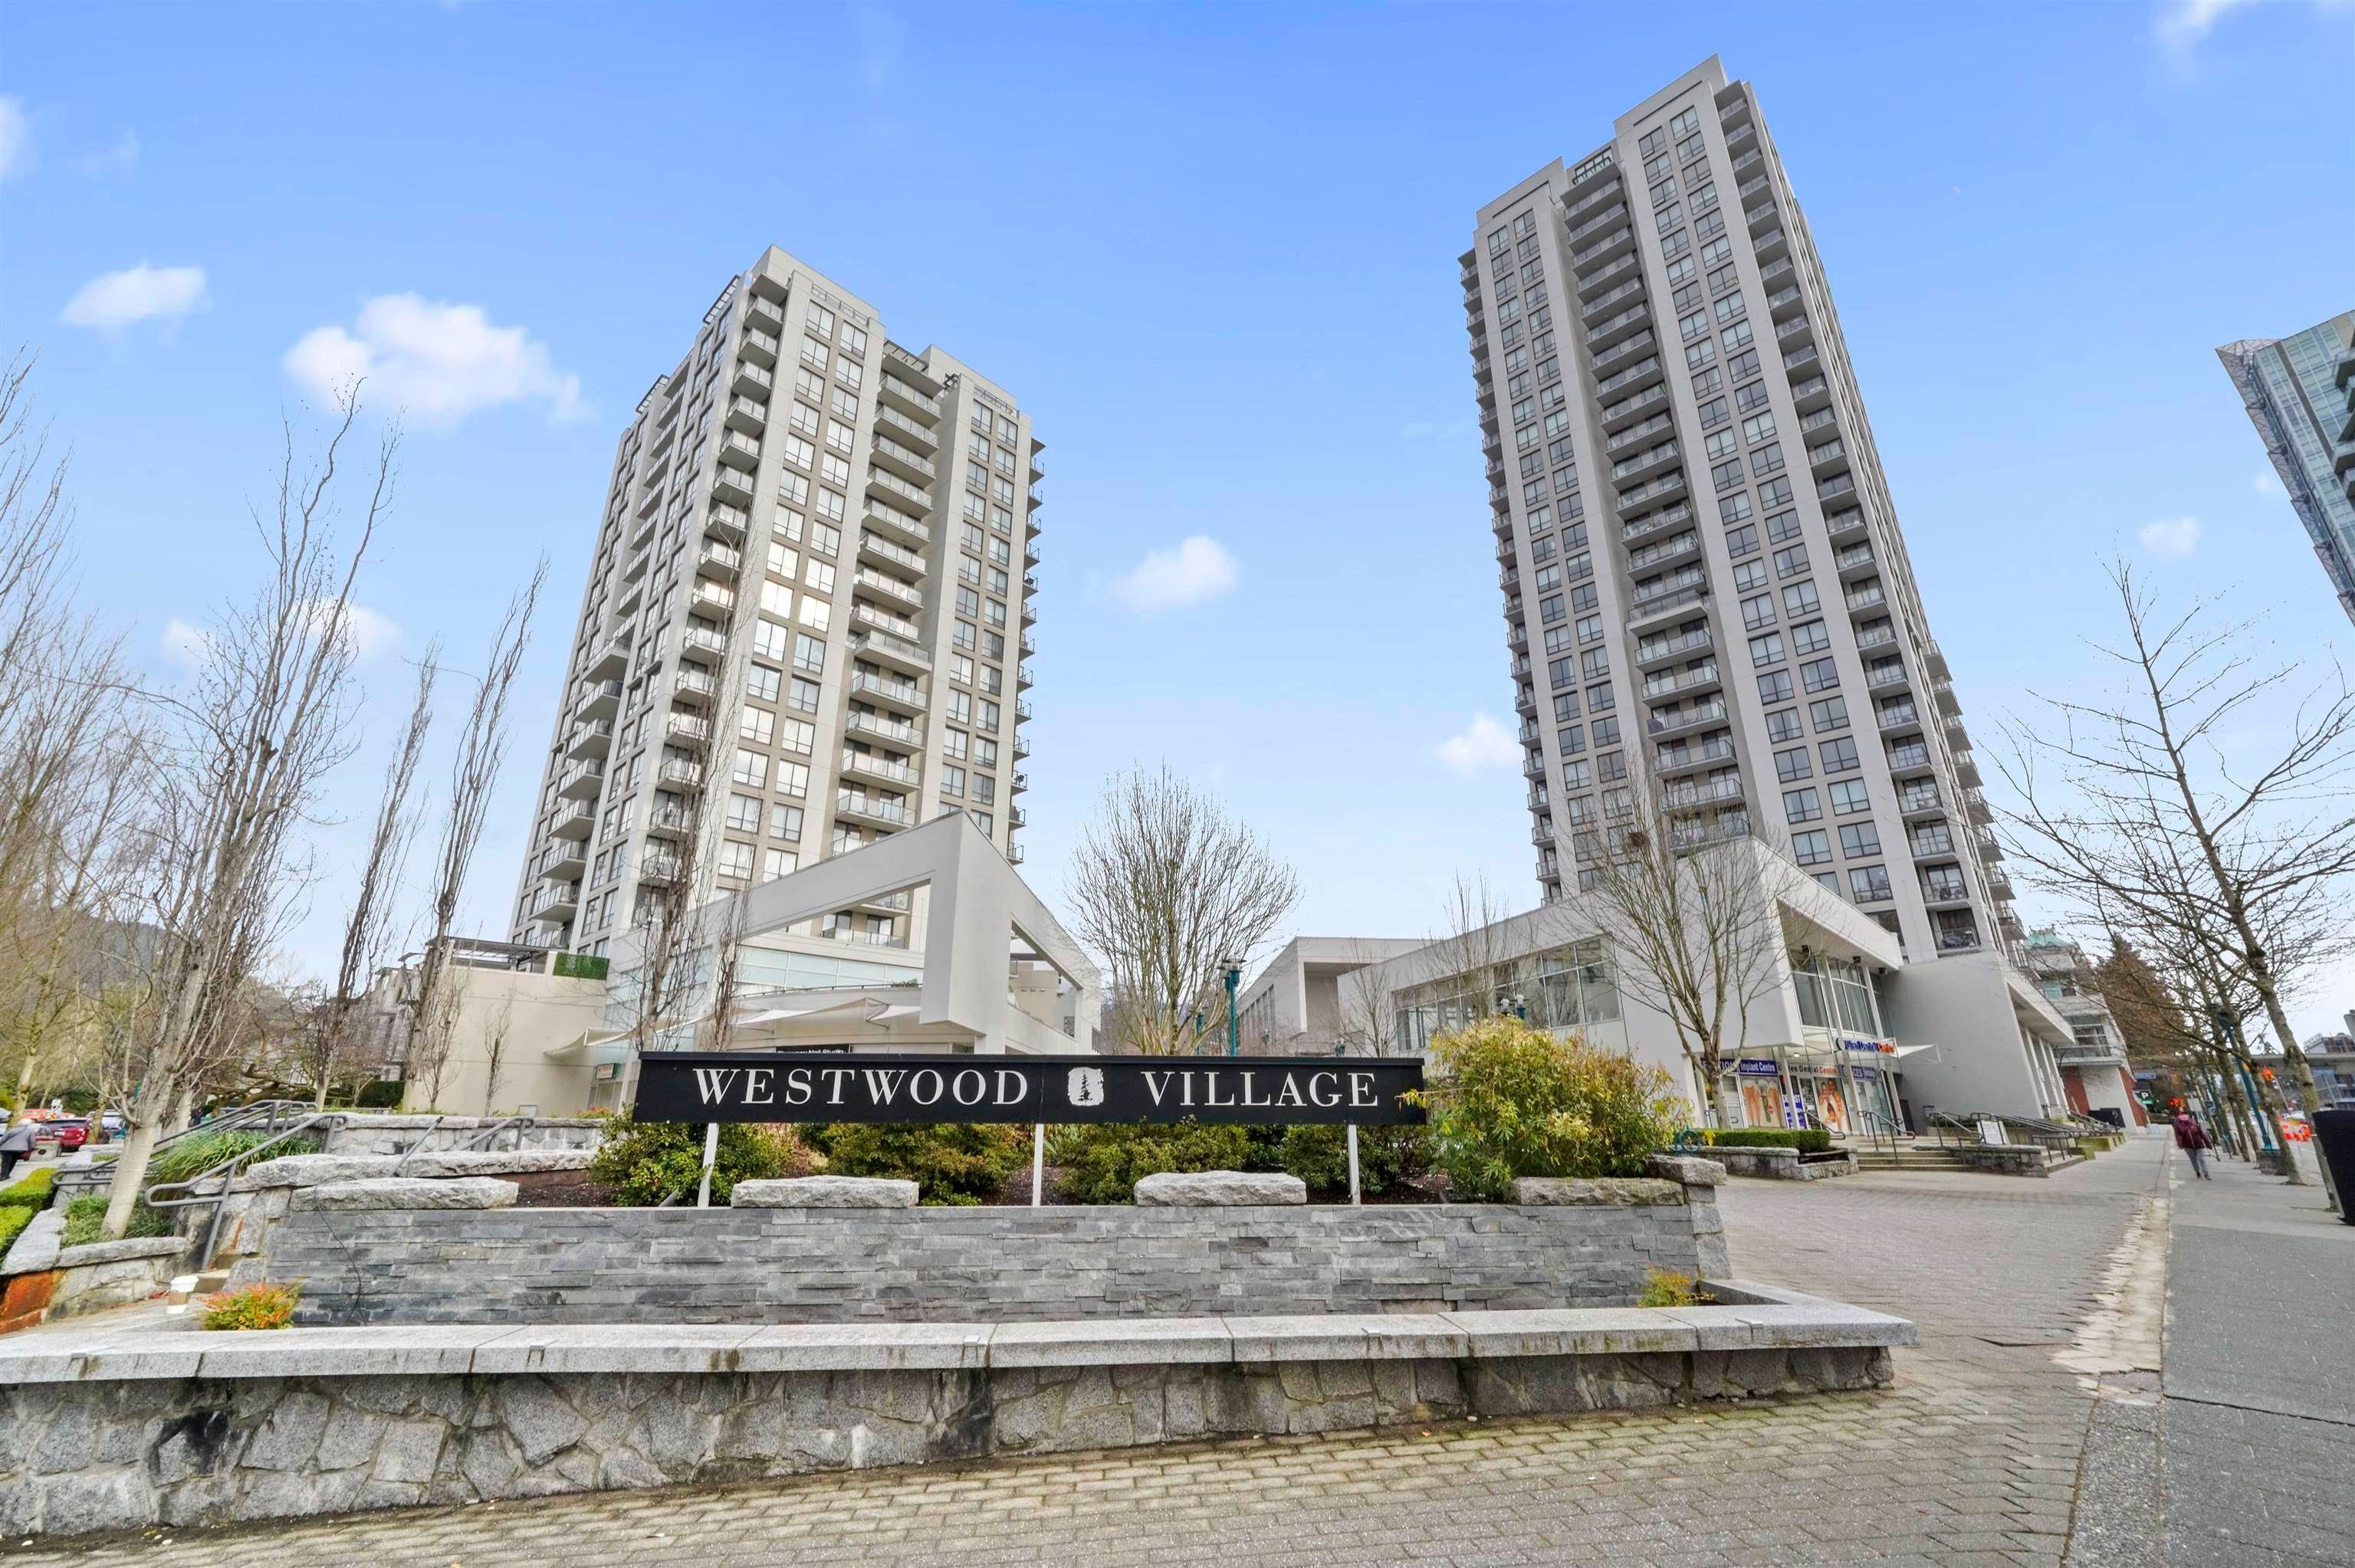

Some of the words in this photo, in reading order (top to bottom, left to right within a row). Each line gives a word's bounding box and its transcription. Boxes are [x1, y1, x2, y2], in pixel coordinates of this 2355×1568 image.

[1759, 1062, 1775, 1072] Centre
[692, 1068, 1028, 1105] WESTWOOD
[1140, 1071, 1378, 1107] VILLAGE
